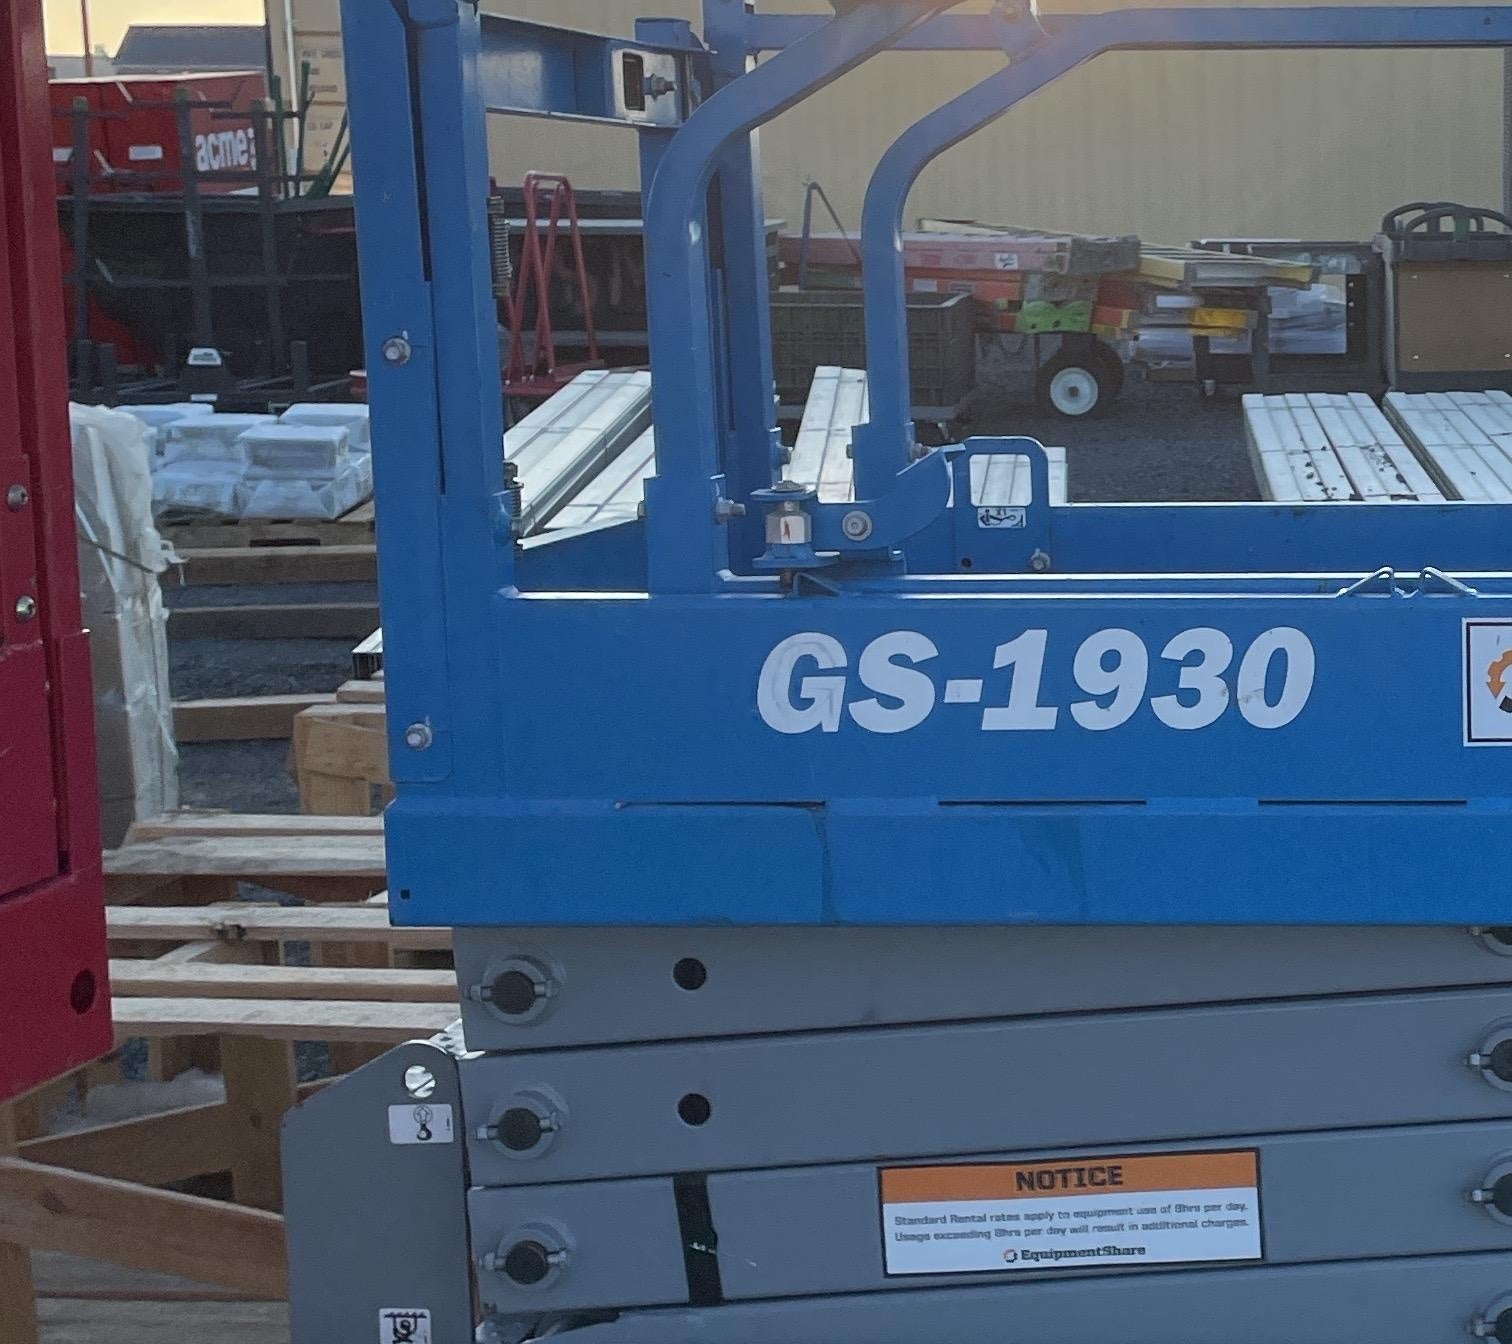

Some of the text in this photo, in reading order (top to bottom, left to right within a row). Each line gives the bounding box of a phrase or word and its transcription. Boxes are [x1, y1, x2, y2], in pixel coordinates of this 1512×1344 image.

[194, 128, 249, 171] acme
[757, 627, 1316, 734] GS-1930
[1016, 1165, 1124, 1192] NOTICE
[894, 1214, 947, 1226] Standard
[950, 1213, 987, 1224] Rental
[989, 1212, 1020, 1222] rates
[1024, 1211, 1054, 1223] apply
[1058, 1210, 1070, 1219] to
[1073, 1206, 1133, 1220] equipment
[1136, 1206, 1157, 1215] use
[1160, 1204, 1171, 1214] of
[1203, 1203, 1221, 1214] per
[894, 1231, 930, 1243] Usage
[934, 1229, 991, 1242] exceeding
[1024, 1228, 1042, 1238] per
[1046, 1226, 1067, 1237] day
[1069, 1223, 1089, 1234] will
[1092, 1221, 1124, 1233] result
[1128, 1221, 1138, 1231] in
[1141, 1219, 1198, 1231] additional
[1021, 1246, 1146, 1262] EquipmentShare
